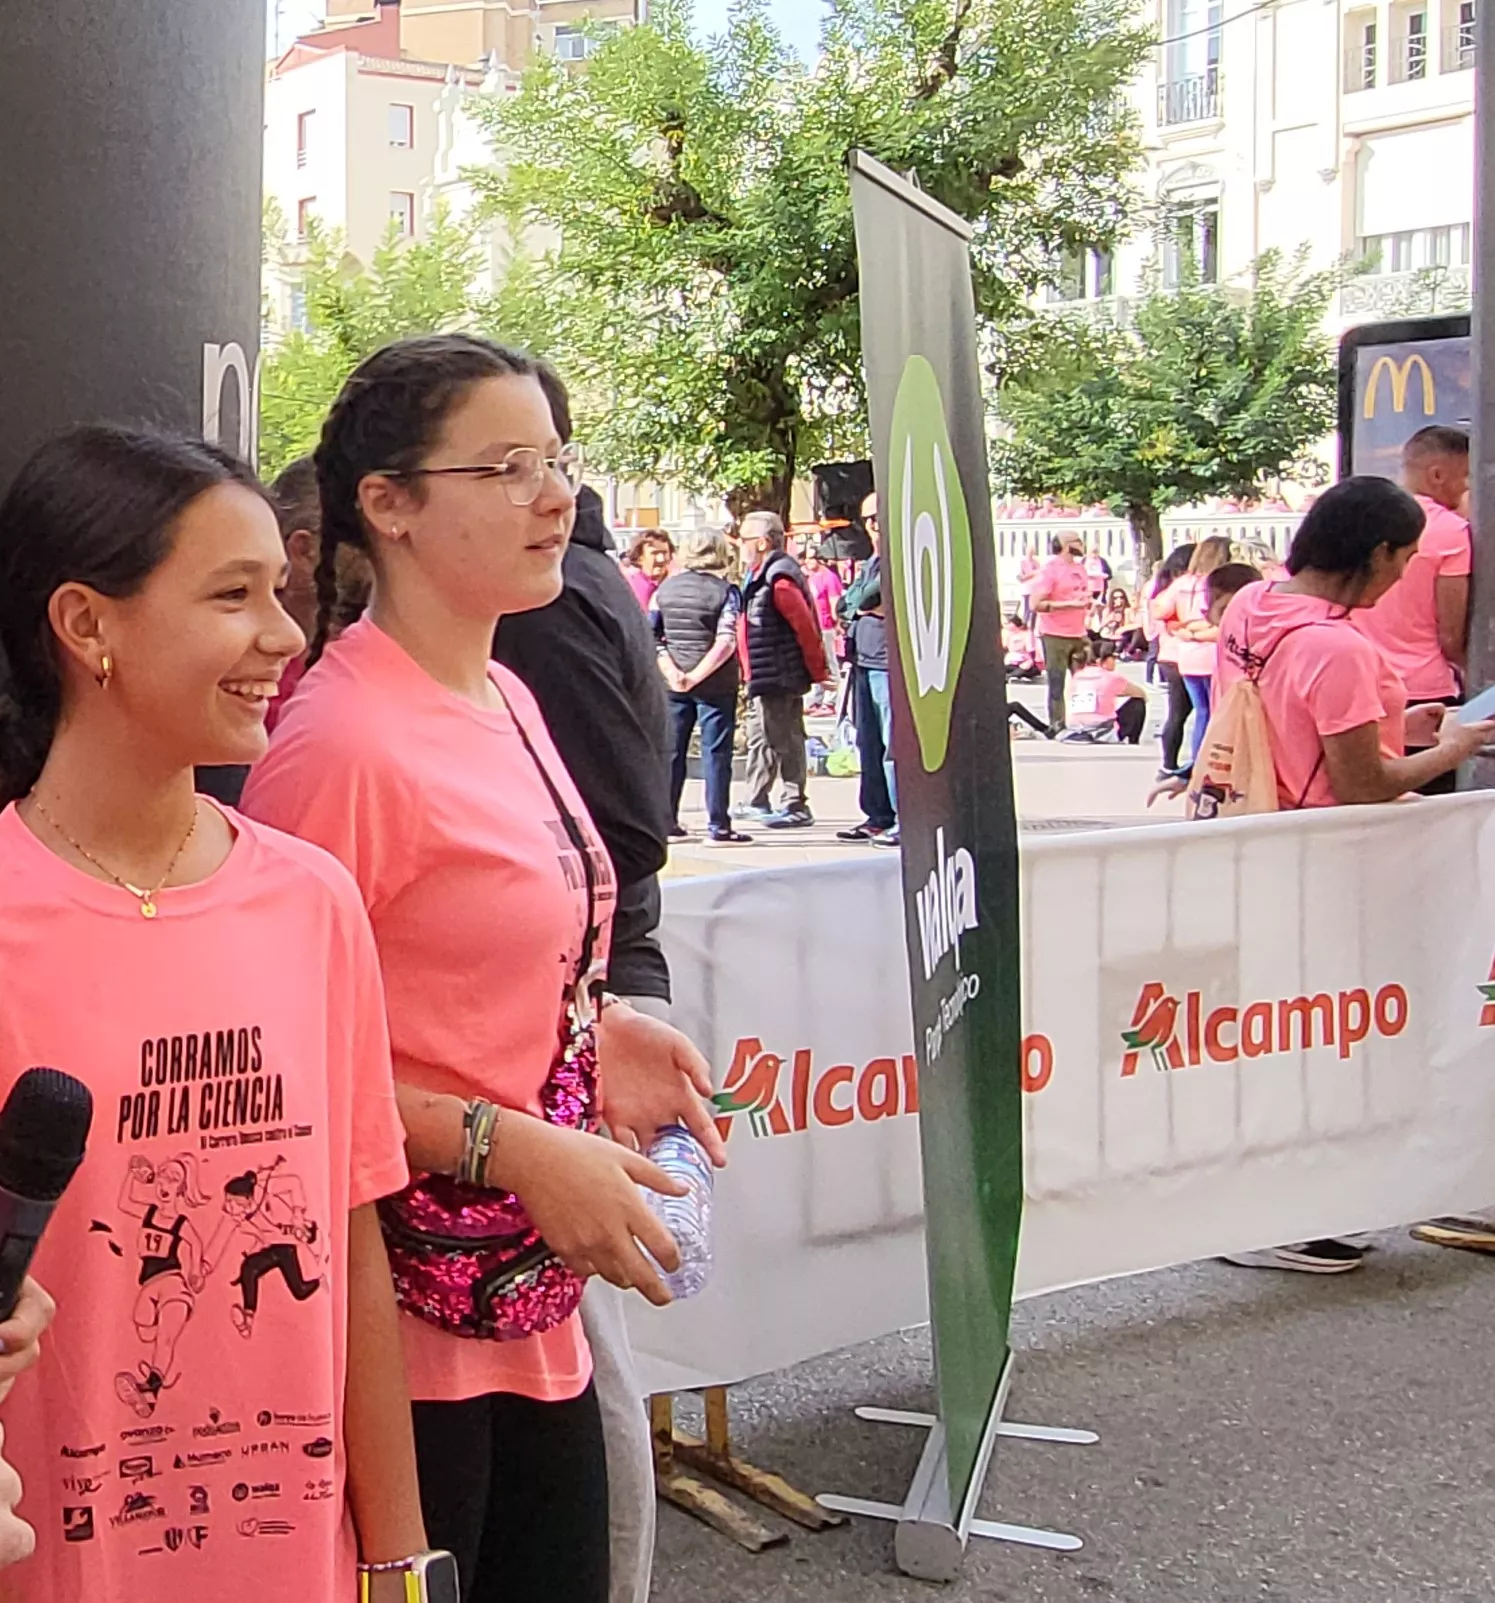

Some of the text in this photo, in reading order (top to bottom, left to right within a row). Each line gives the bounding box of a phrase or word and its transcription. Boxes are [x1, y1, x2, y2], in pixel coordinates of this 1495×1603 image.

[141, 1025, 263, 1087] CORRAMOS
[1120, 981, 1408, 1077] Alcampo
[117, 1073, 284, 1144] POR LA CIENCIA
[241, 1441, 290, 1458] URBAN
